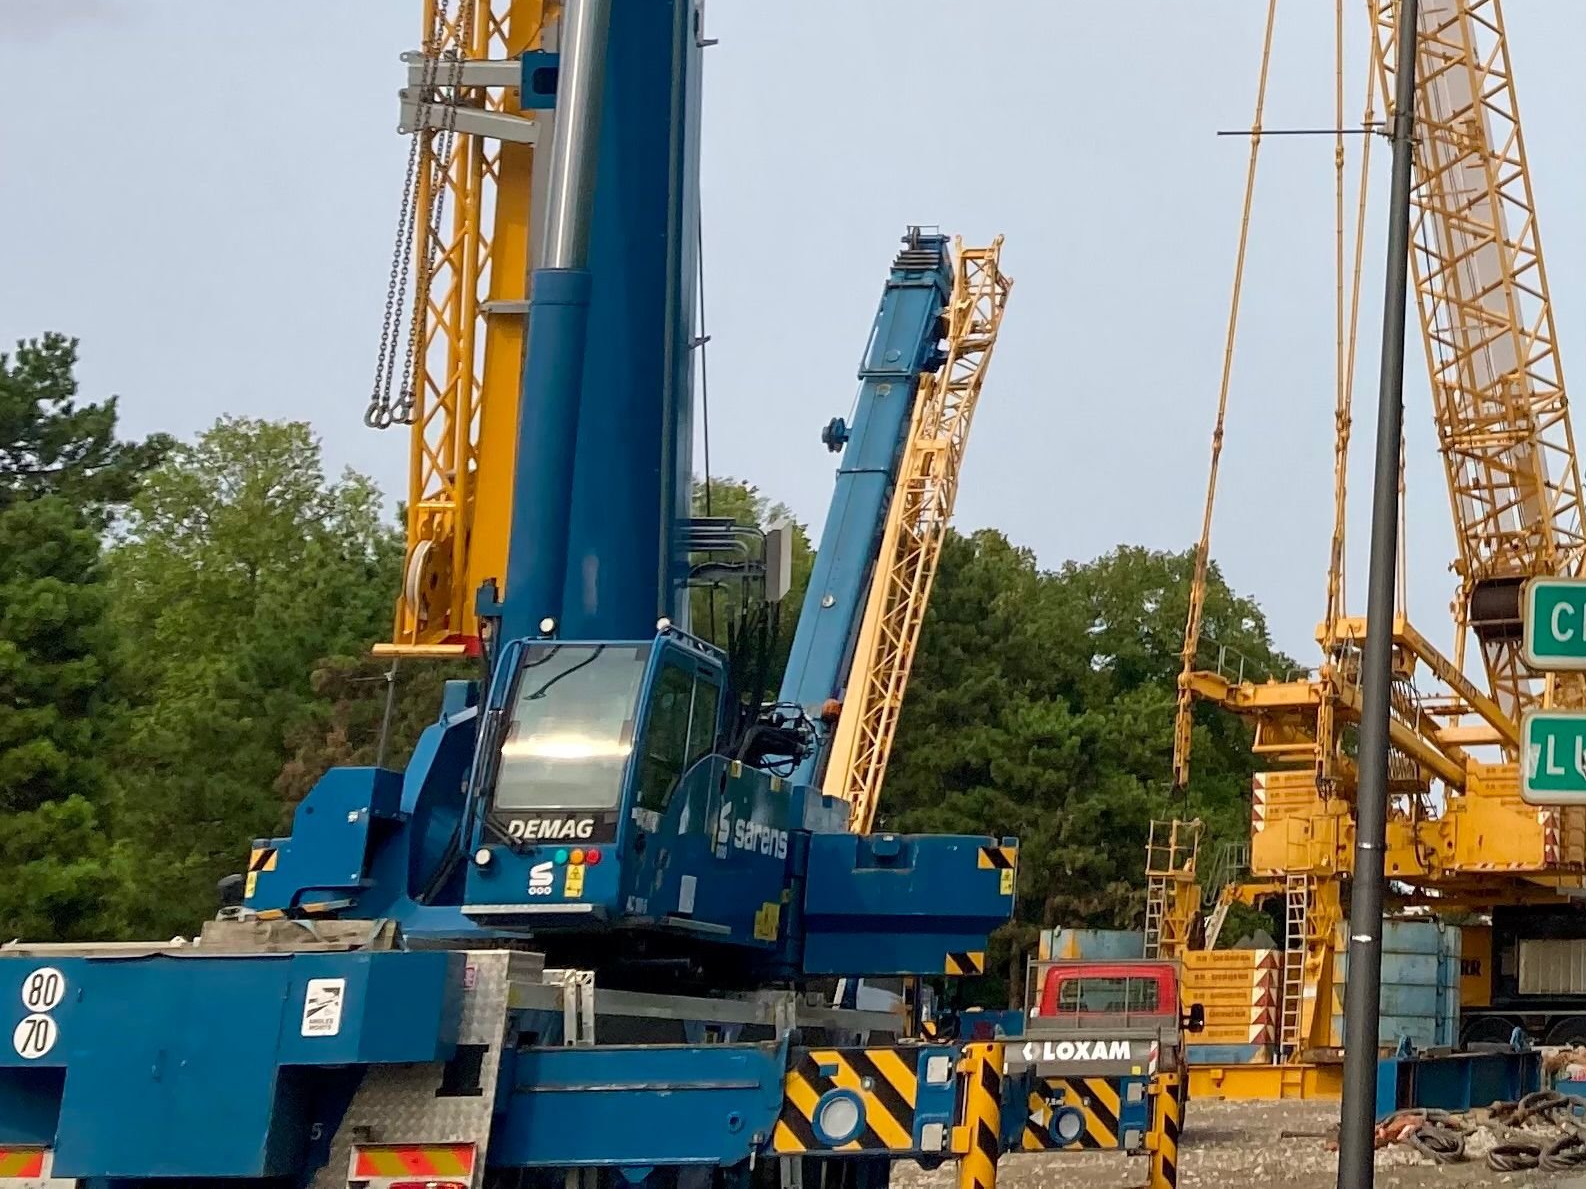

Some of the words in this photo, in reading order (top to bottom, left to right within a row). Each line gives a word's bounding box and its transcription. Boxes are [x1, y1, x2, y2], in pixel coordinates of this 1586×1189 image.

[509, 819, 594, 839] DEMAG
[734, 818, 788, 859] sarens
[28, 973, 59, 1007] 80
[21, 1019, 49, 1053] 70
[1043, 1041, 1131, 1060] LOXAM
